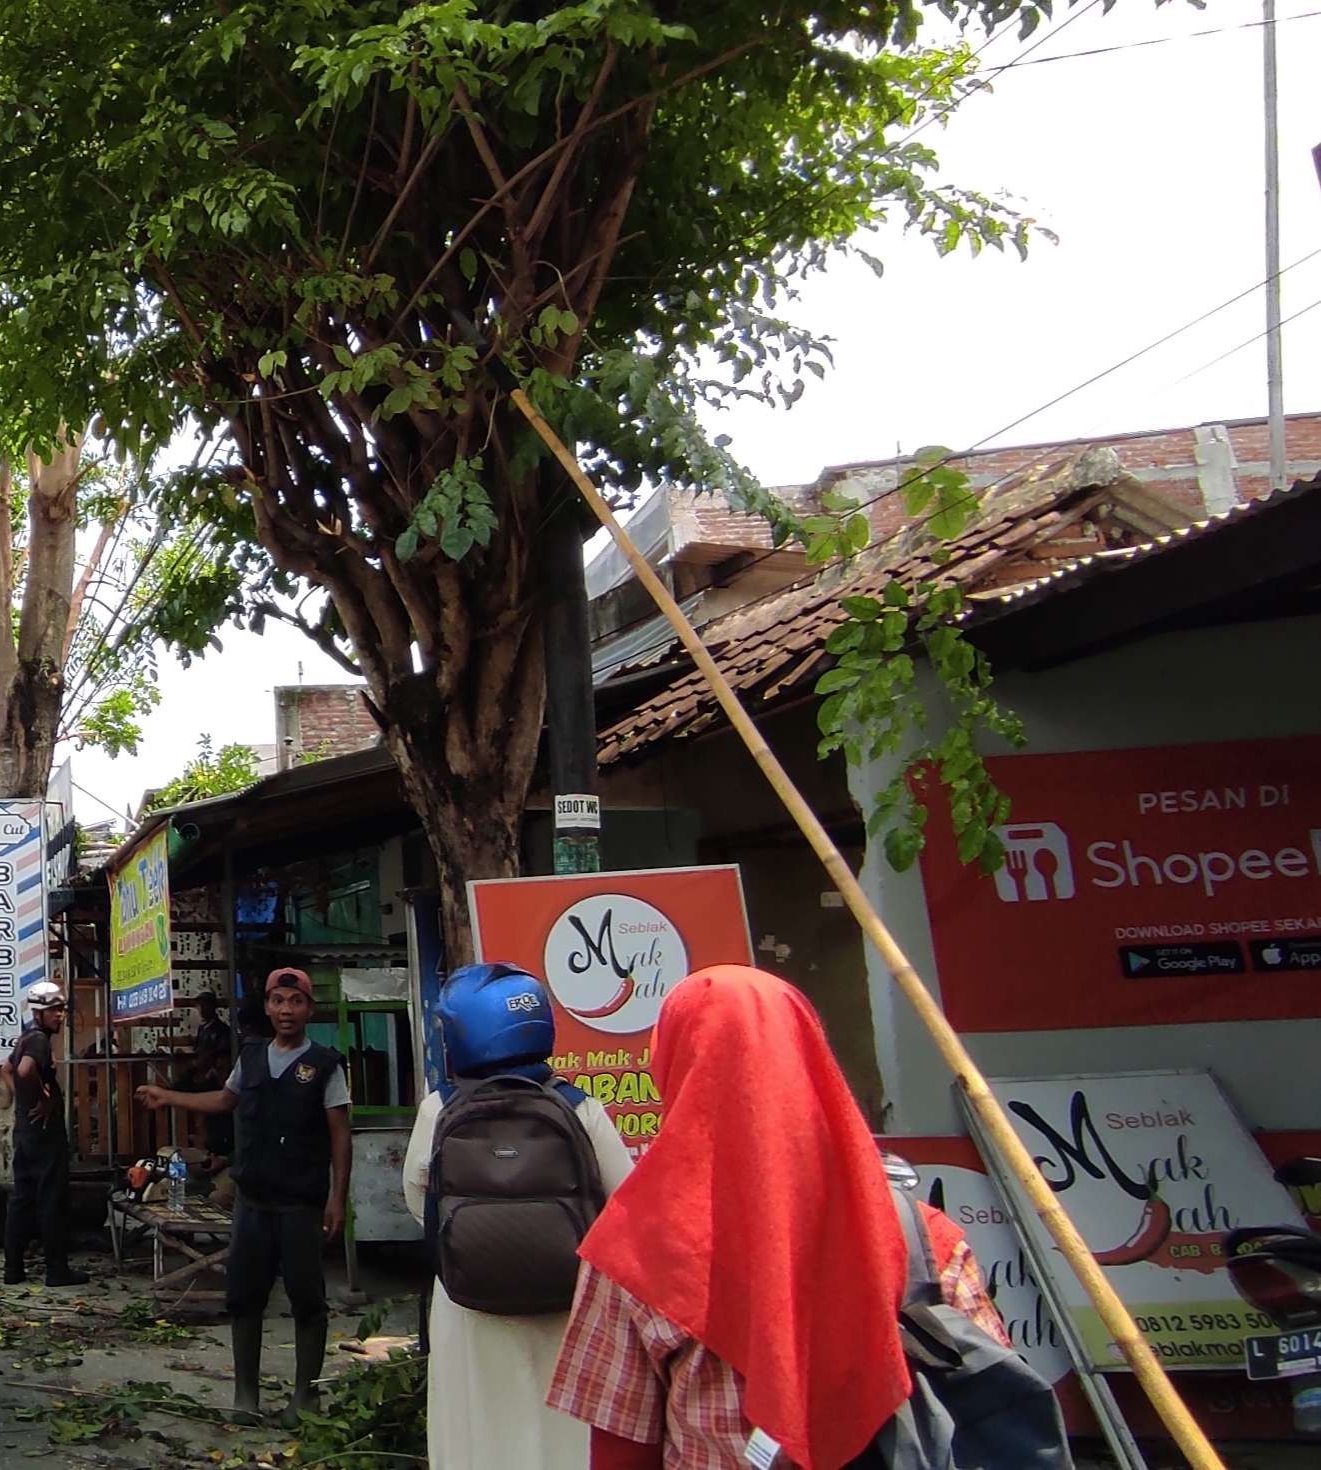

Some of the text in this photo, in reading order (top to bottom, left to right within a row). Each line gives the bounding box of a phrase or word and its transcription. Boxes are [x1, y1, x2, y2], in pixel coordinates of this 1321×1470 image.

[557, 800, 584, 814] SEDOT
[1138, 785, 1288, 814] PESAN DI
[3, 823, 25, 836] Cut
[618, 921, 668, 934] Seblak
[1115, 922, 1205, 940] DOWNLOAD
[1209, 919, 1272, 935] SHOPEE
[1157, 952, 1237, 971] Google Play
[586, 1049, 632, 1068] Mak
[1106, 1110, 1195, 1130] Seblak
[1190, 1313, 1241, 1331] 5983
[1245, 1312, 1280, 1328] 50
[1252, 1340, 1265, 1357] L
